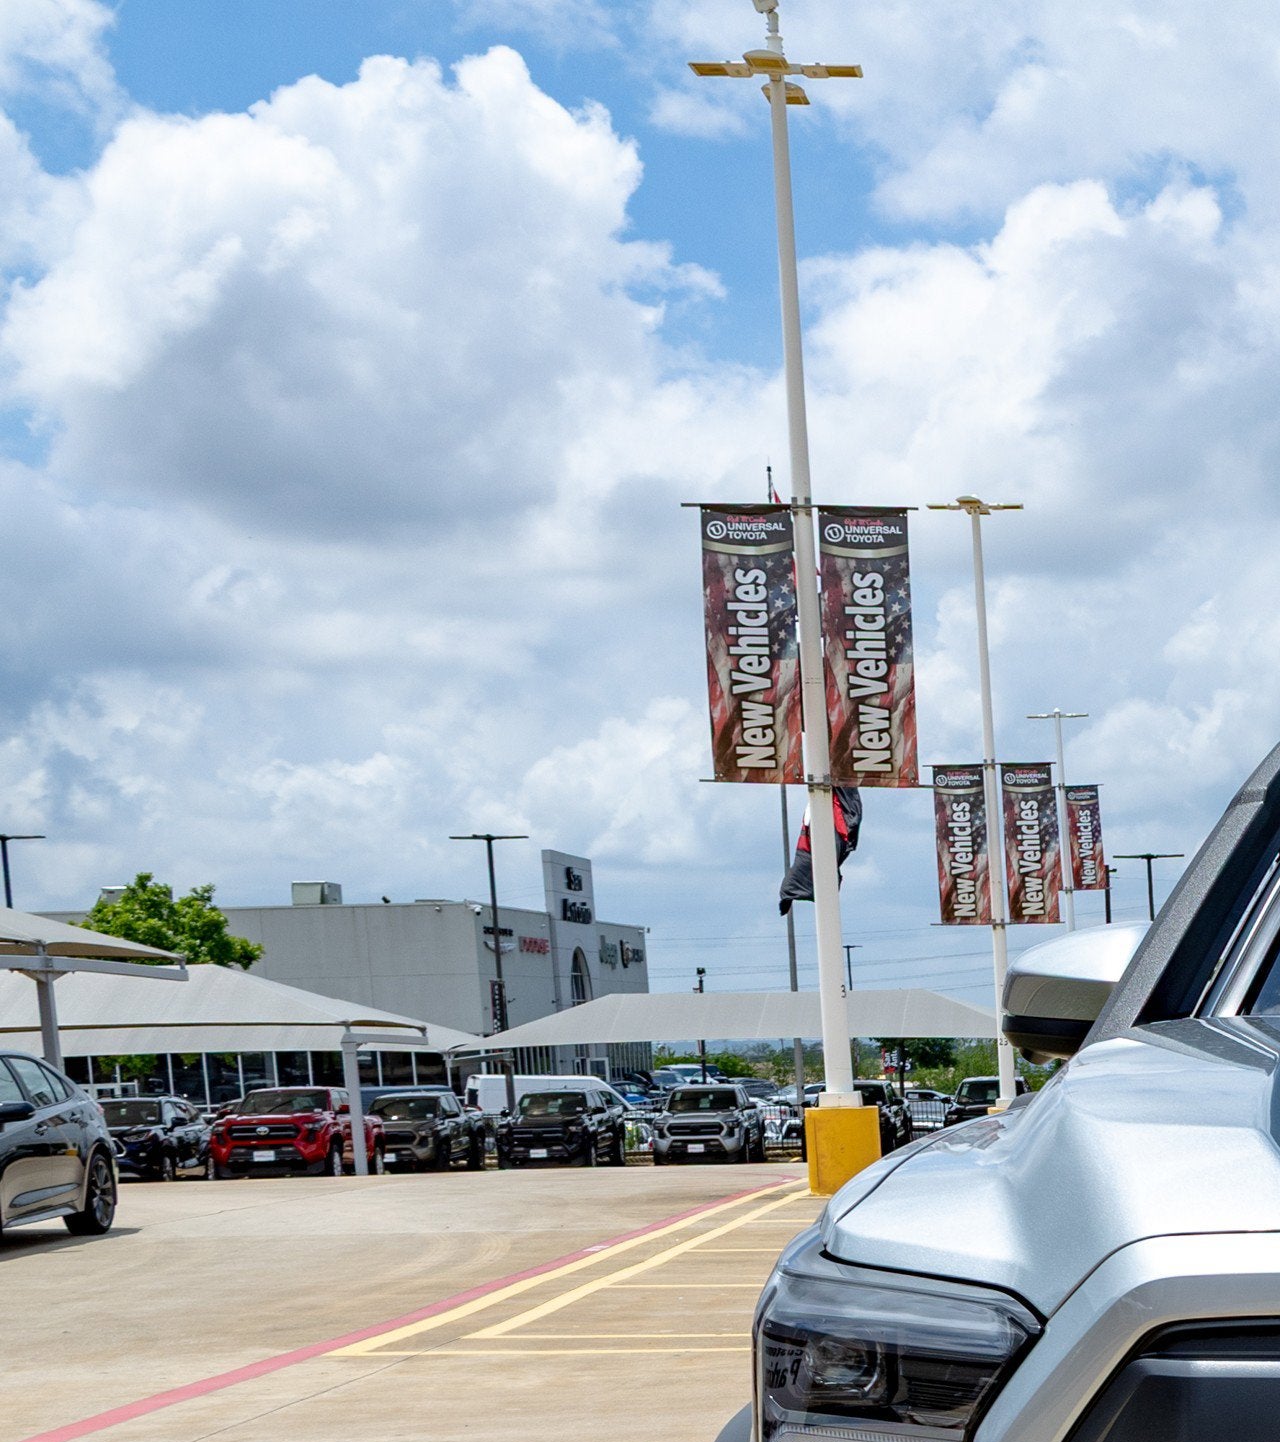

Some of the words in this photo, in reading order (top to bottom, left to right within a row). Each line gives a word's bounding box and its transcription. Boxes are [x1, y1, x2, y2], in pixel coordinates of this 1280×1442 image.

[727, 522, 786, 531] UNIVERSAL
[728, 531, 768, 540] TOYOTA
[844, 526, 903, 535] UNIVERSAL
[845, 534, 885, 543] TOYOTA
[727, 568, 772, 695] Vehicles
[845, 572, 888, 698] Vehicles
[735, 701, 778, 768] New
[852, 704, 892, 772] New
[948, 801, 974, 875] Vehicles
[1016, 800, 1041, 874] Vehicles
[1076, 809, 1094, 858] Vehicles
[1081, 859, 1097, 885] New
[954, 878, 977, 917] New
[1022, 877, 1045, 915] New
